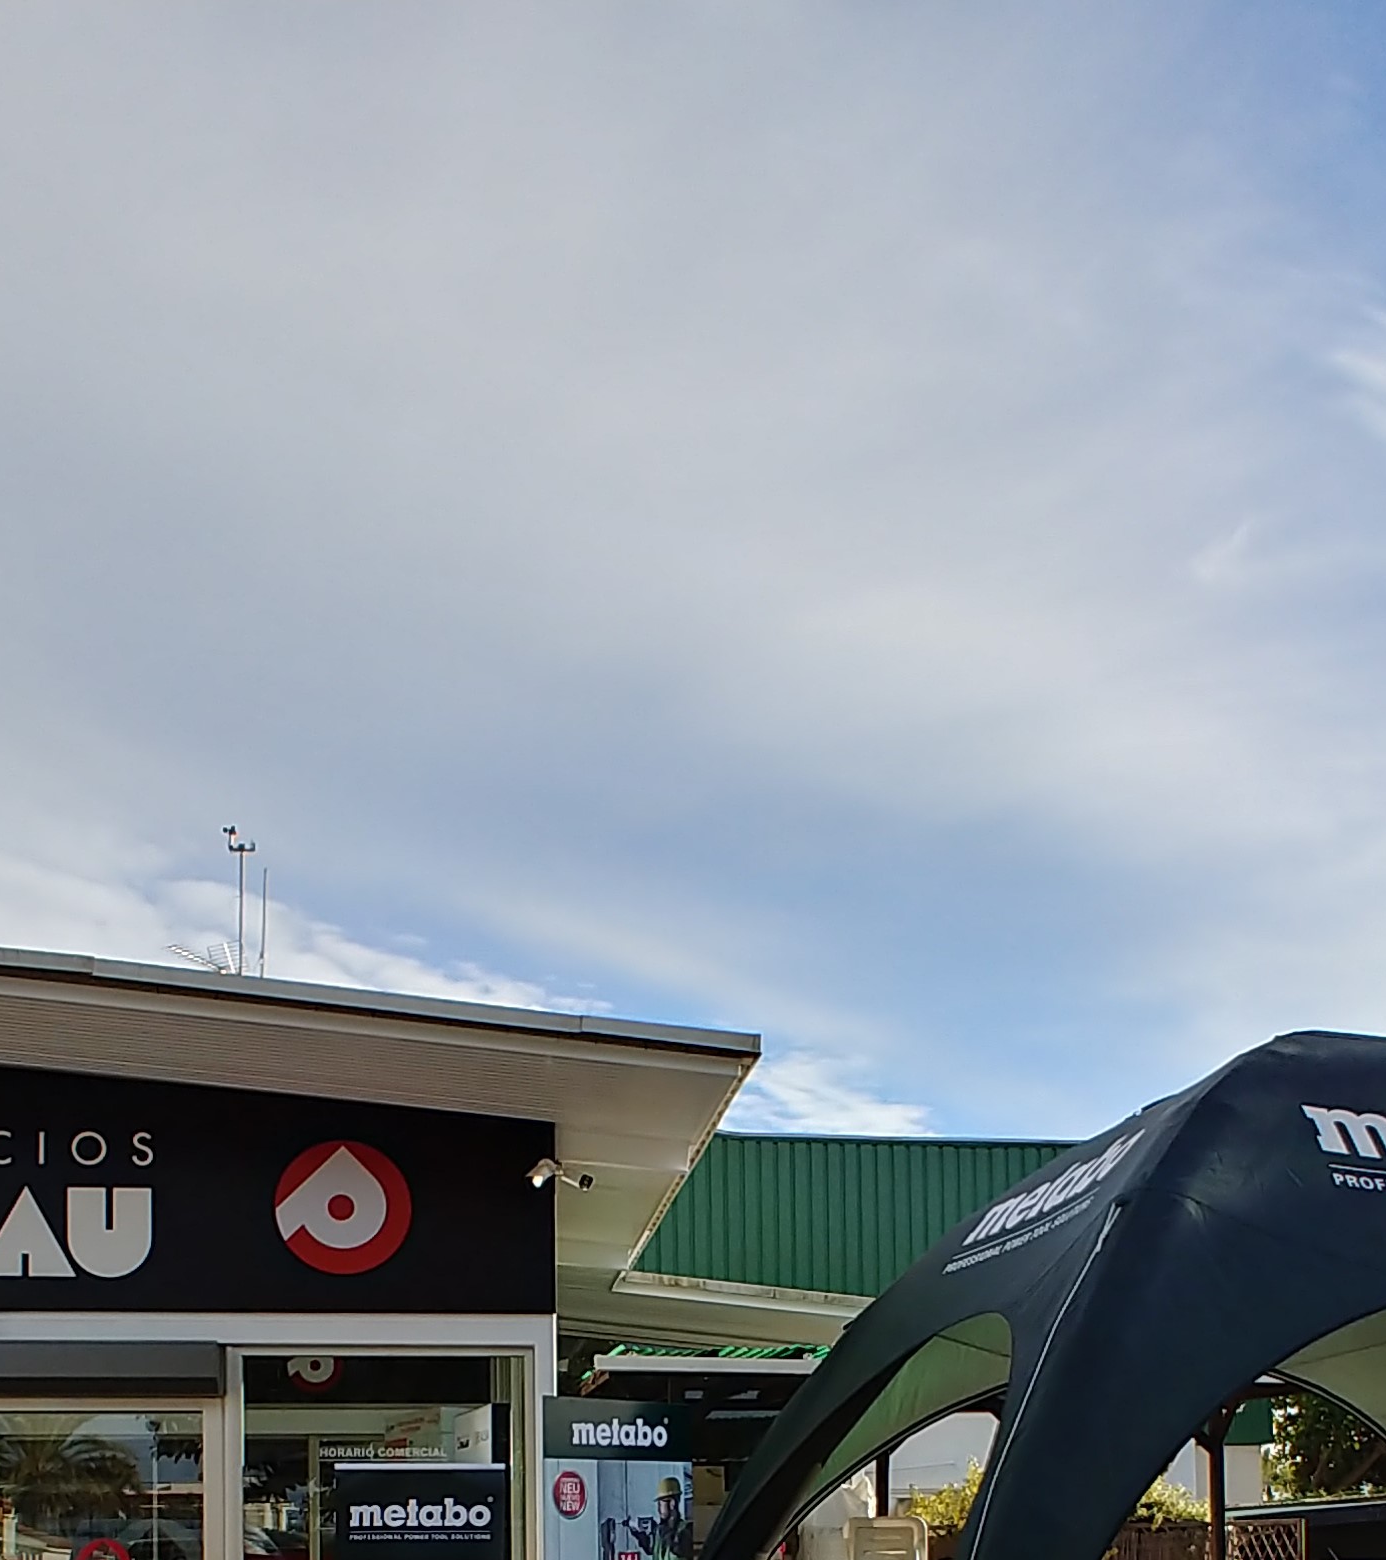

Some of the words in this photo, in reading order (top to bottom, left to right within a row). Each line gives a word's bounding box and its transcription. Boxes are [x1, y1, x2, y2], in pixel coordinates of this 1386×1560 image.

[571, 1417, 668, 1448] metabo
[319, 1446, 374, 1458] HORARIO
[377, 1446, 447, 1458] COMERCIAL
[560, 1482, 580, 1494] NEU
[349, 1497, 491, 1527] metabo
